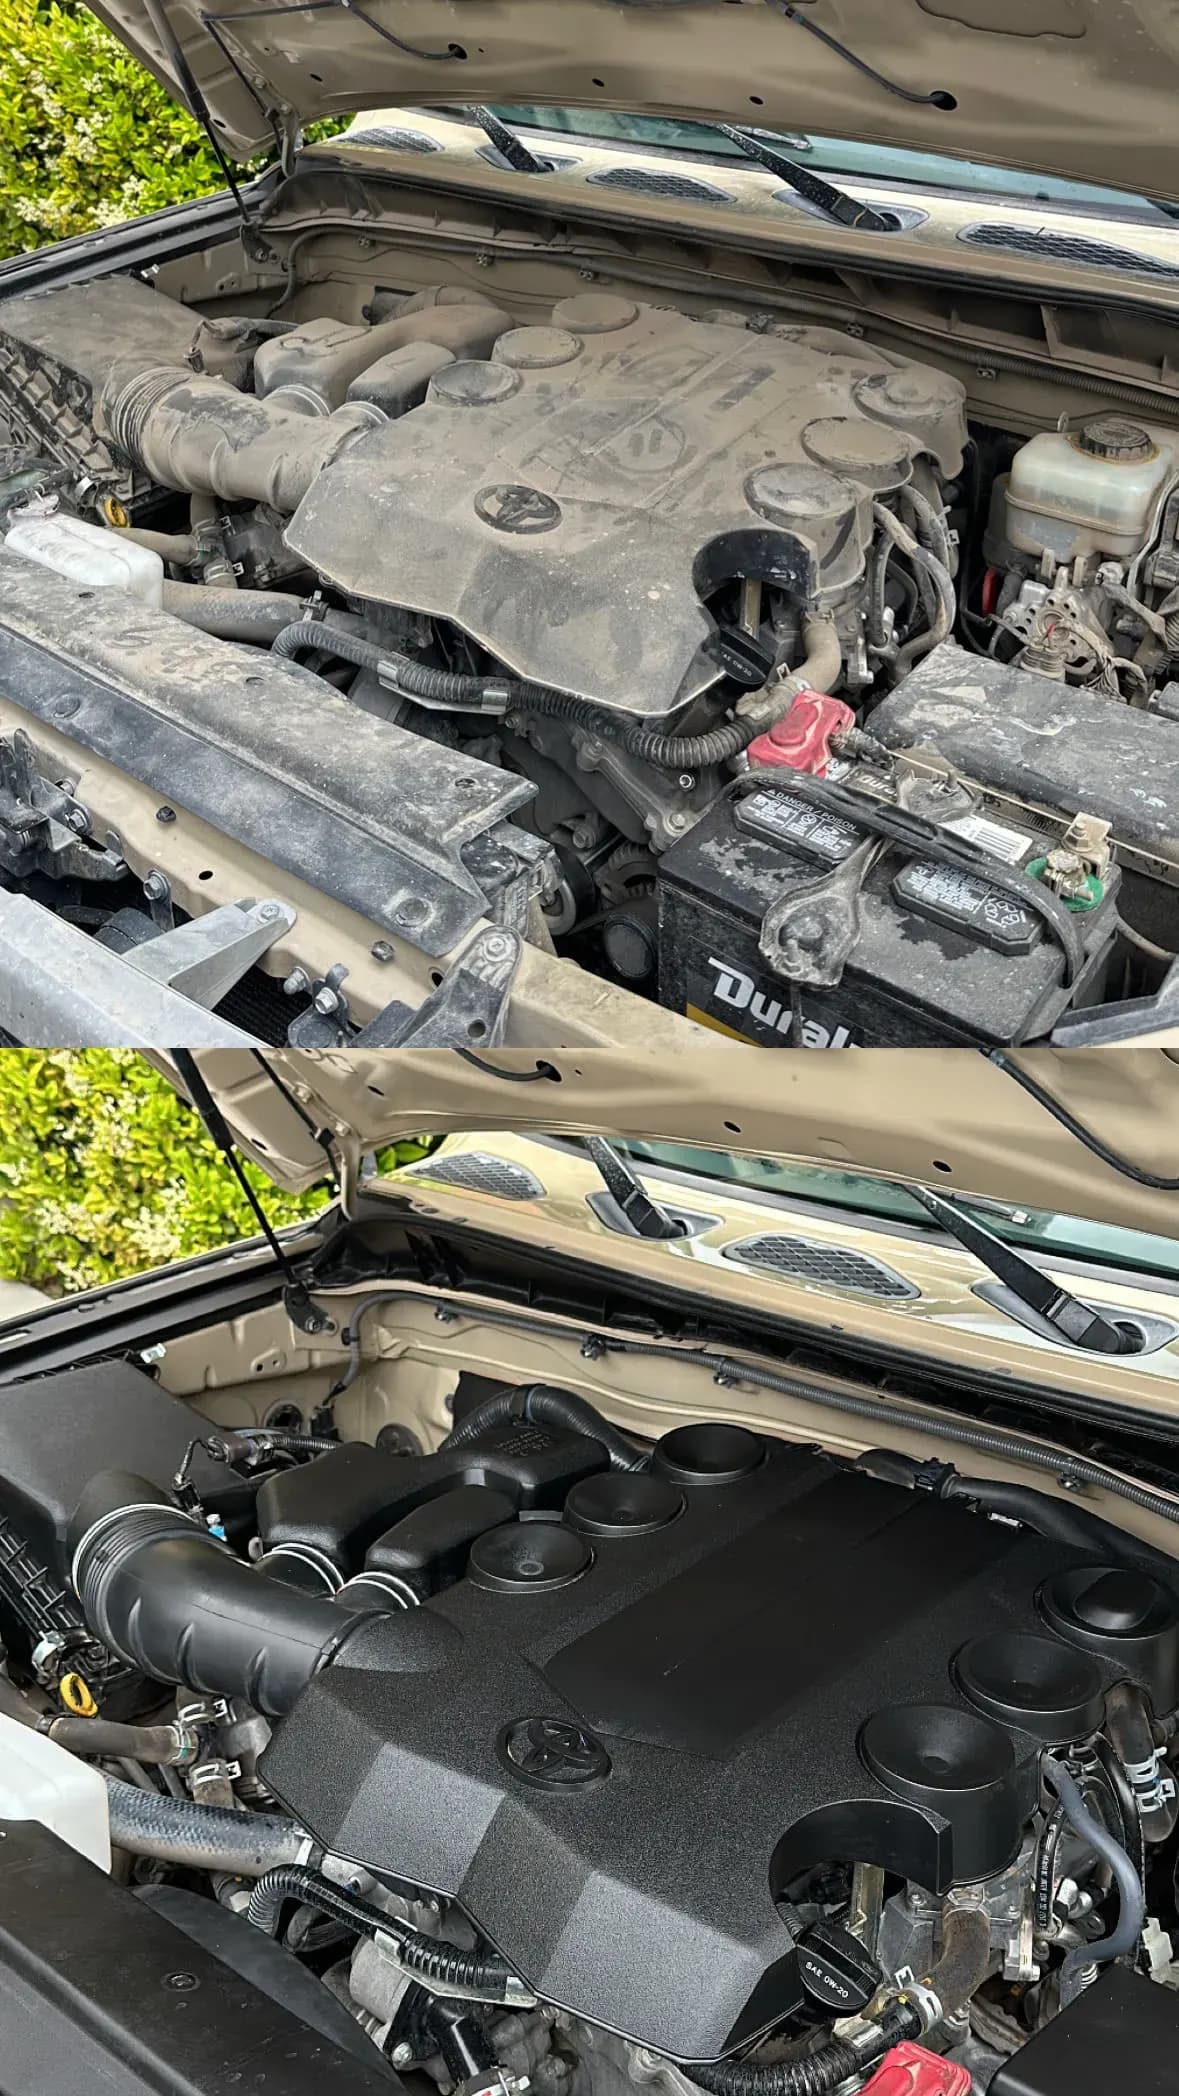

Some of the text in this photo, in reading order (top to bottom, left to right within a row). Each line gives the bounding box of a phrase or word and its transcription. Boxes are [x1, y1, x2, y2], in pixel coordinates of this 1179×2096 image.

[776, 791, 814, 812] DANGER
[822, 811, 857, 831] POISON
[708, 956, 864, 1048] Dural
[805, 1961, 849, 1998] SAE 0W-20
